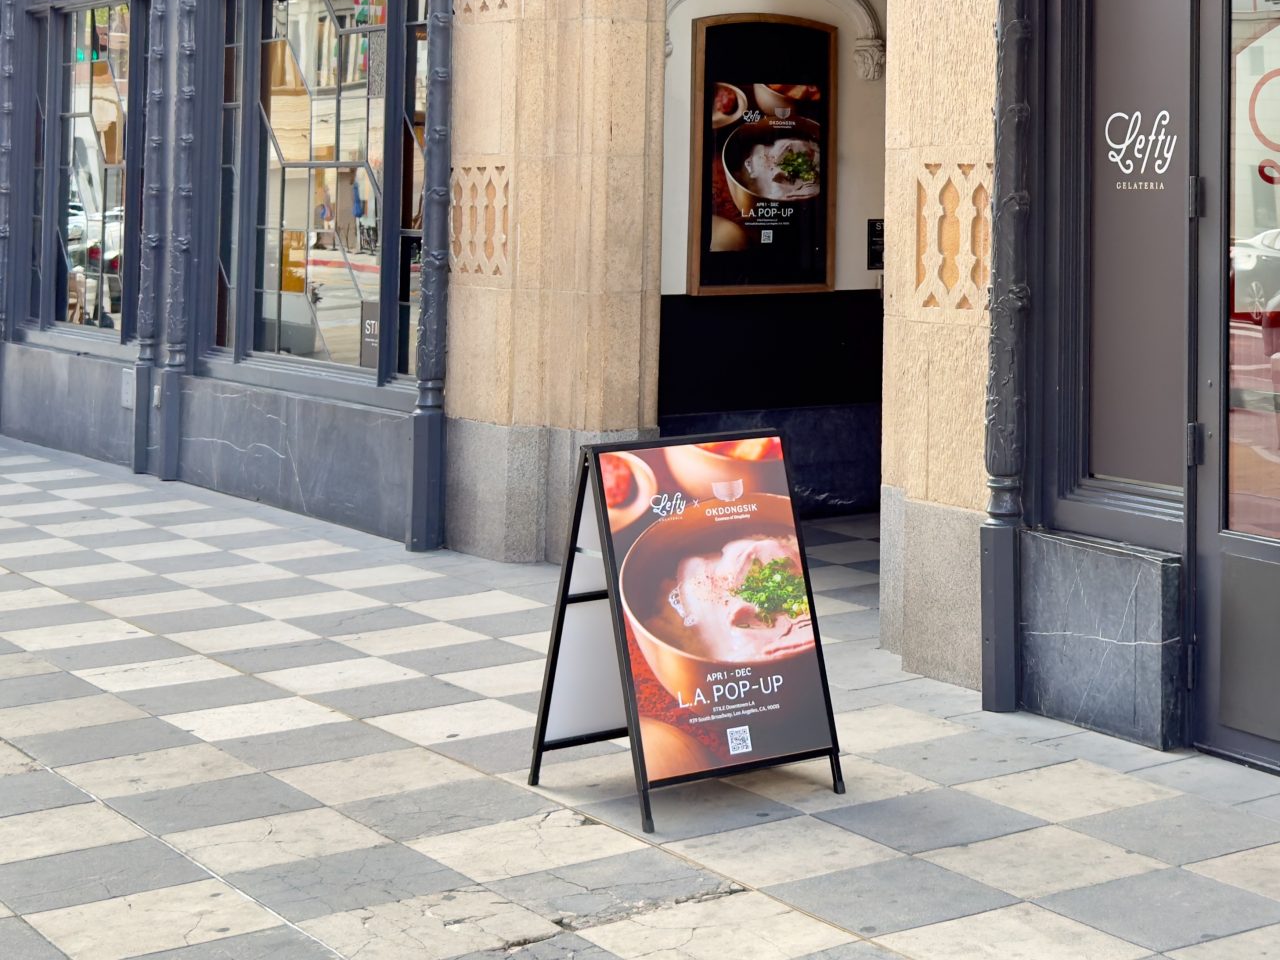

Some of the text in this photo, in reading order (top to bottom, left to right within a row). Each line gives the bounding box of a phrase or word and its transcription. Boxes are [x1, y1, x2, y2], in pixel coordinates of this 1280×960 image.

[1105, 110, 1177, 174] Lefty
[1116, 181, 1165, 190] GELATERIA
[758, 208, 794, 217] POP-UP
[649, 492, 686, 516] Lefty
[705, 503, 758, 516] OKDONGSIK
[706, 671, 723, 682] APR
[735, 667, 752, 677] DEC
[677, 675, 783, 708] L.A. POP-UP
